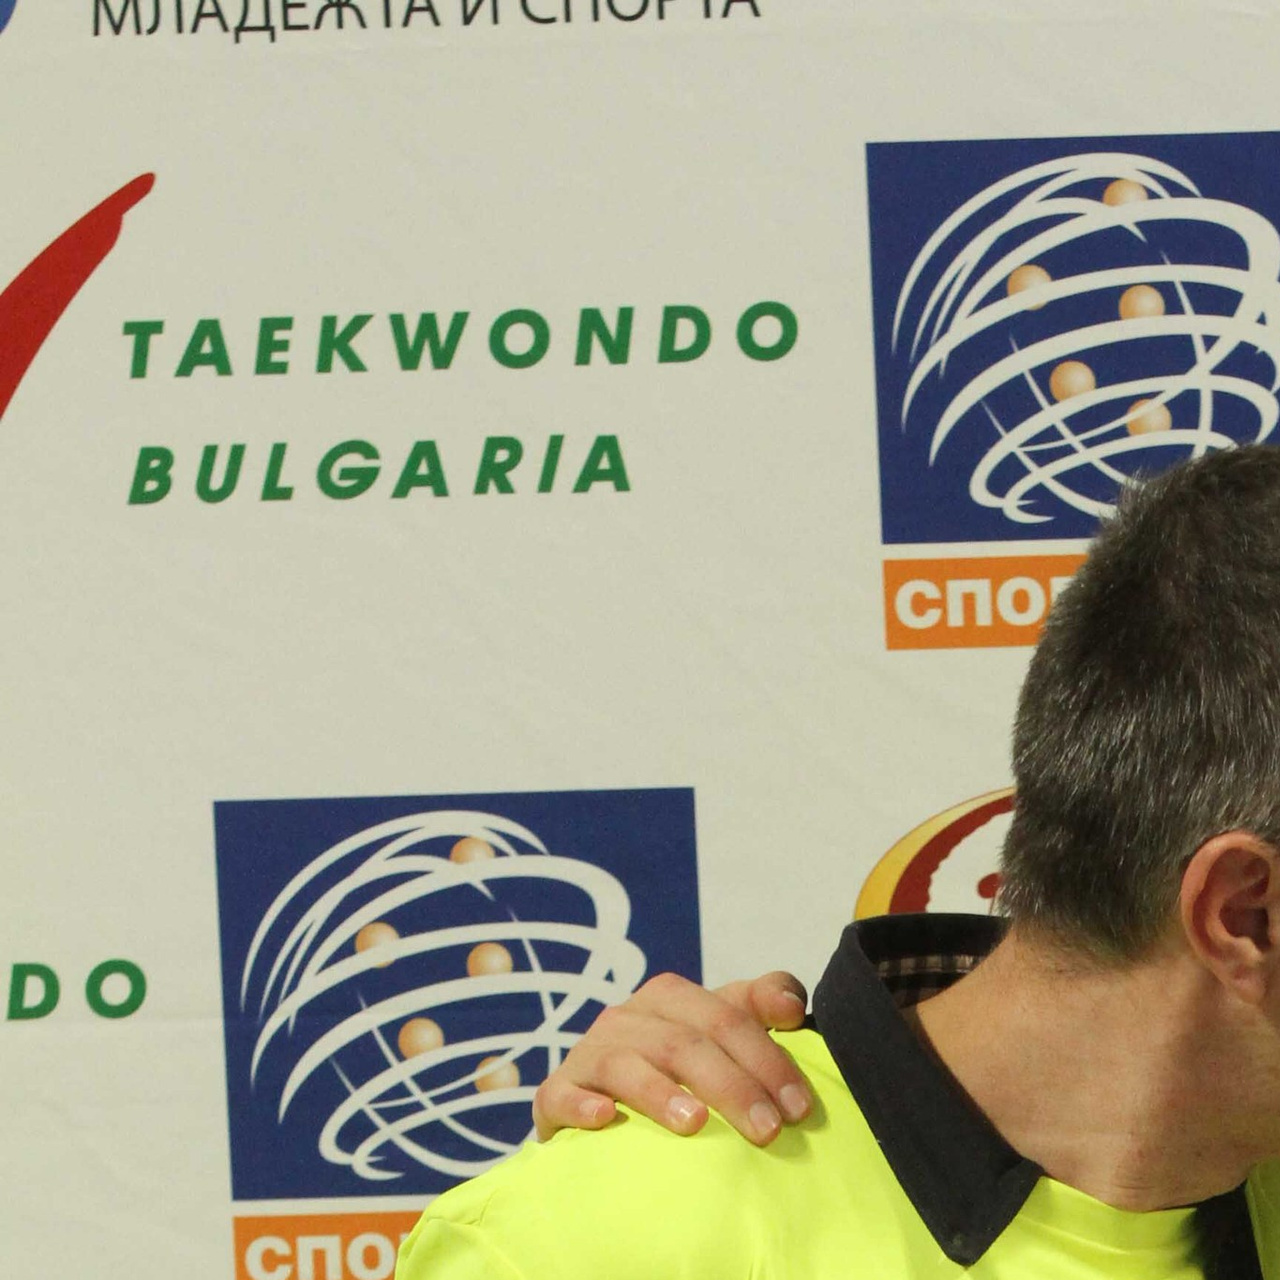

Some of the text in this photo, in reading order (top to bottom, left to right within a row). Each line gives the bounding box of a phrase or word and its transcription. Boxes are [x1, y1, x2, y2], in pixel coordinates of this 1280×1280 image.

[122, 301, 798, 379] TAEKWONDO
[128, 435, 632, 505] BULGARIA
[894, 576, 1078, 630] СПО
